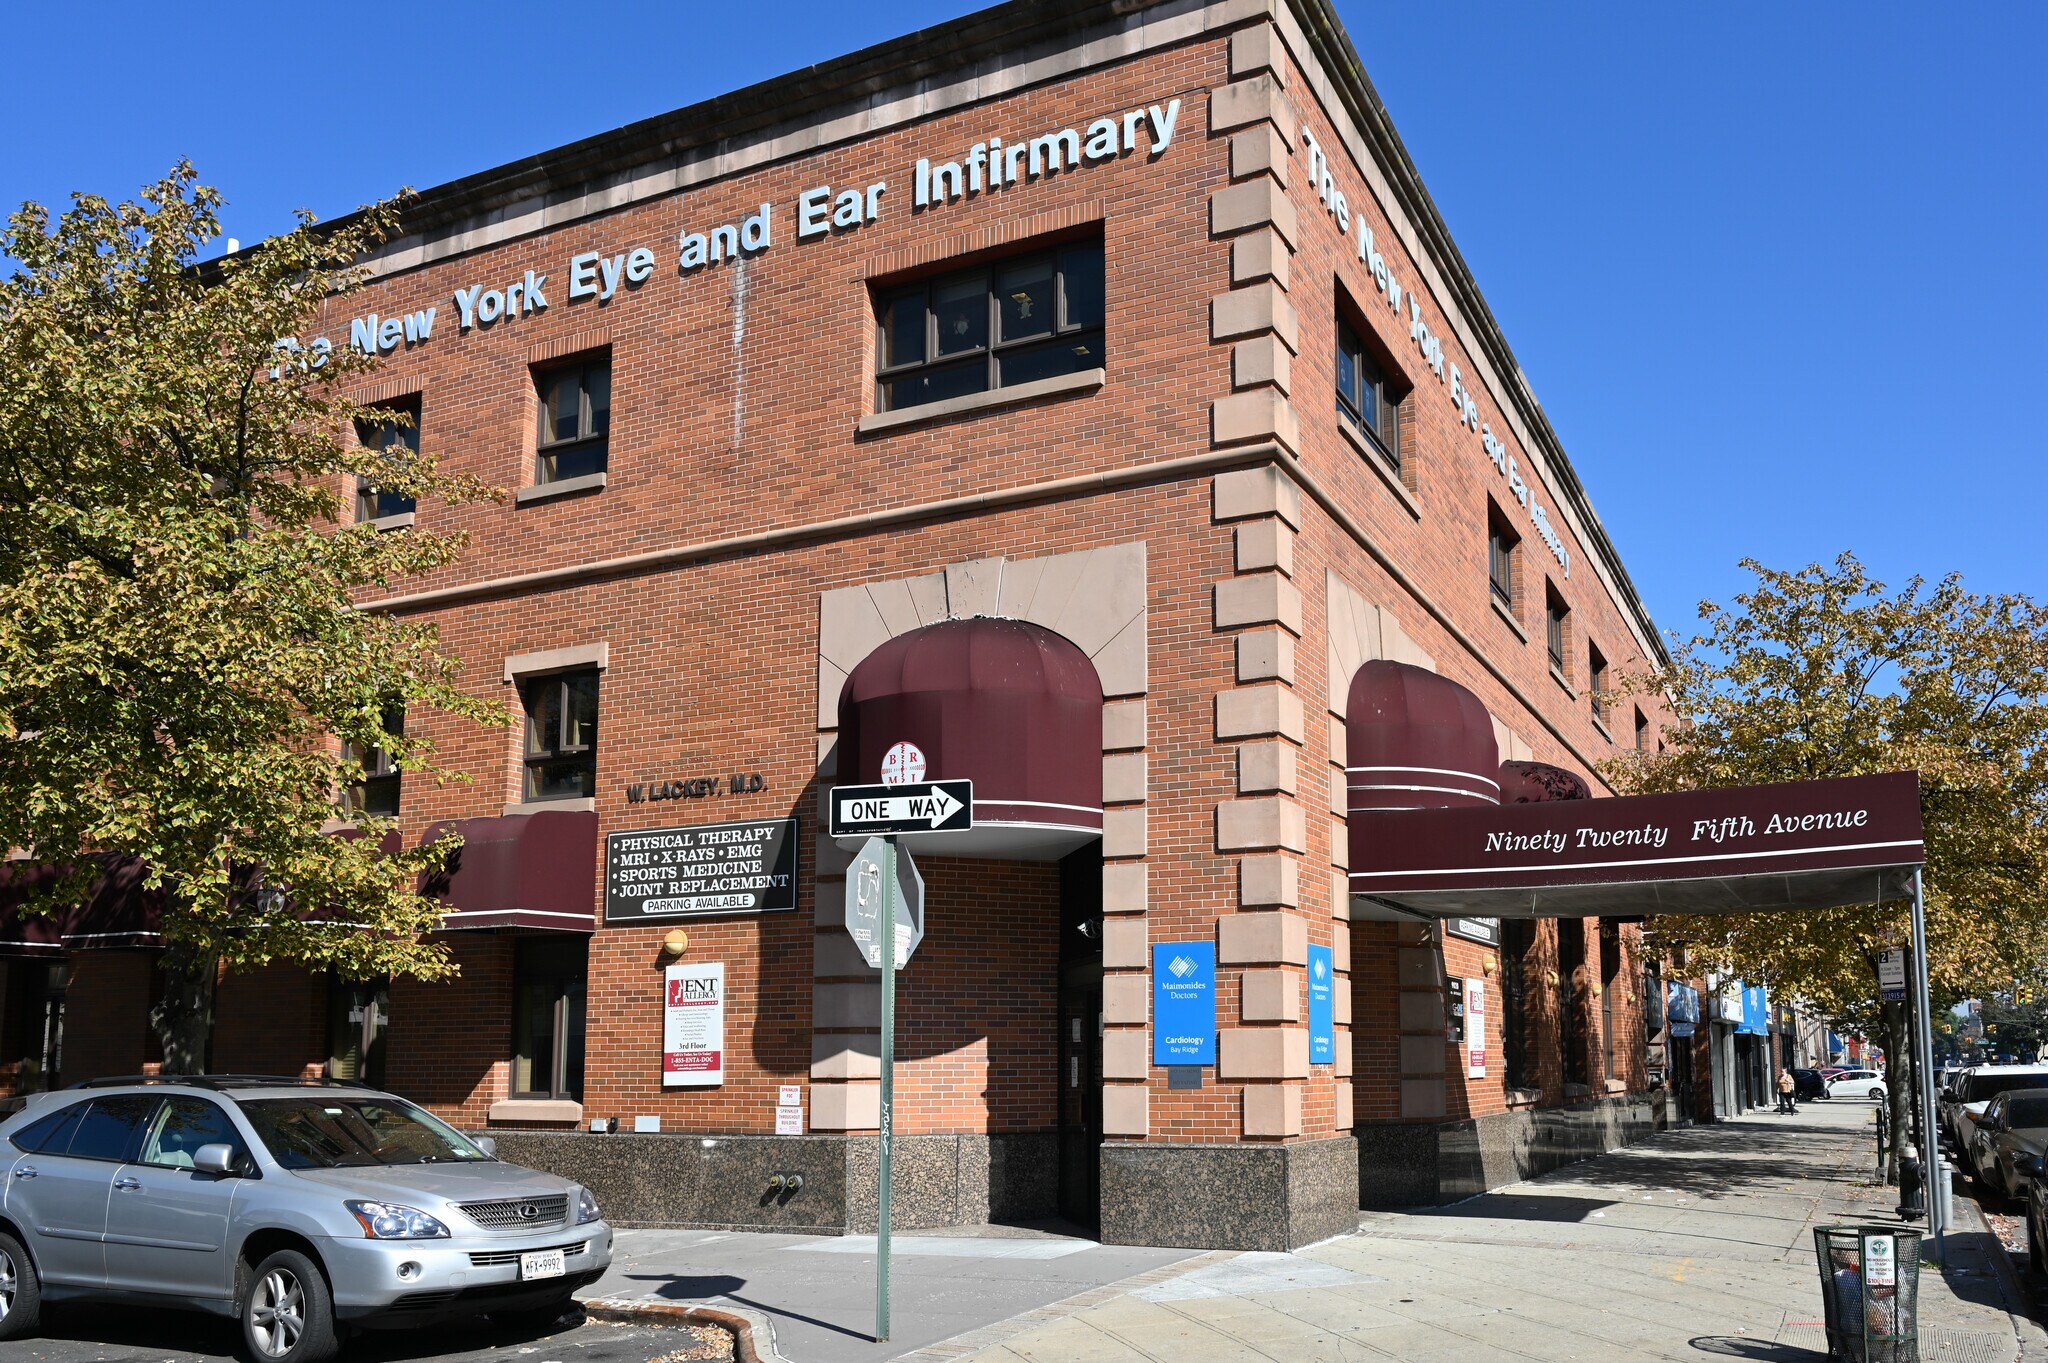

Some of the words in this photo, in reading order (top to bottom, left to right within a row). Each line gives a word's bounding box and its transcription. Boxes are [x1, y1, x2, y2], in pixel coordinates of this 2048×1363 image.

[350, 307, 436, 355] New
[453, 269, 548, 329] York
[568, 250, 655, 301] Eye
[678, 202, 771, 269] and
[798, 181, 886, 237] Ear
[914, 97, 1182, 208] Infirmary
[1302, 125, 1349, 235] The
[1357, 213, 1402, 315] New
[1406, 291, 1446, 385] York
[1450, 361, 1478, 432] Eye
[1482, 422, 1506, 476] and
[1508, 455, 1528, 509] Ear
[1529, 489, 1570, 580] Infirmary
[889, 754, 897, 765] B
[909, 751, 918, 763] R
[627, 784, 646, 804] W.
[649, 777, 723, 801] LACKEY,
[730, 773, 769, 793] M.D.
[851, 800, 890, 820] ONE
[908, 797, 950, 818] WAY
[1483, 830, 1568, 853] Ninety
[1575, 823, 1669, 848] Twenty
[1690, 815, 1756, 844] Fifth
[1763, 808, 1869, 835] Avenue
[620, 834, 694, 852] PHYSICAL
[698, 827, 775, 846] THERAPY
[619, 853, 651, 867] MRI
[660, 847, 716, 864] X-RAYS
[726, 843, 763, 860] EMG
[619, 866, 678, 883] SPORTS
[682, 859, 763, 878] MEDICINE
[618, 883, 664, 898] JOINT
[668, 874, 789, 895] REPLACEMENT
[647, 898, 692, 912] PARKING
[695, 895, 750, 909] AVAILABLE
[1881, 952, 1887, 963] 2
[684, 978, 718, 993] ENT
[1161, 982, 1206, 990] Maimonides
[684, 990, 718, 1000] ALLERGY
[1170, 991, 1198, 999] Doctors
[690, 1041, 707, 1049] Floor
[1165, 1036, 1204, 1045] Cardiology
[1182, 1045, 1199, 1053] Ridge
